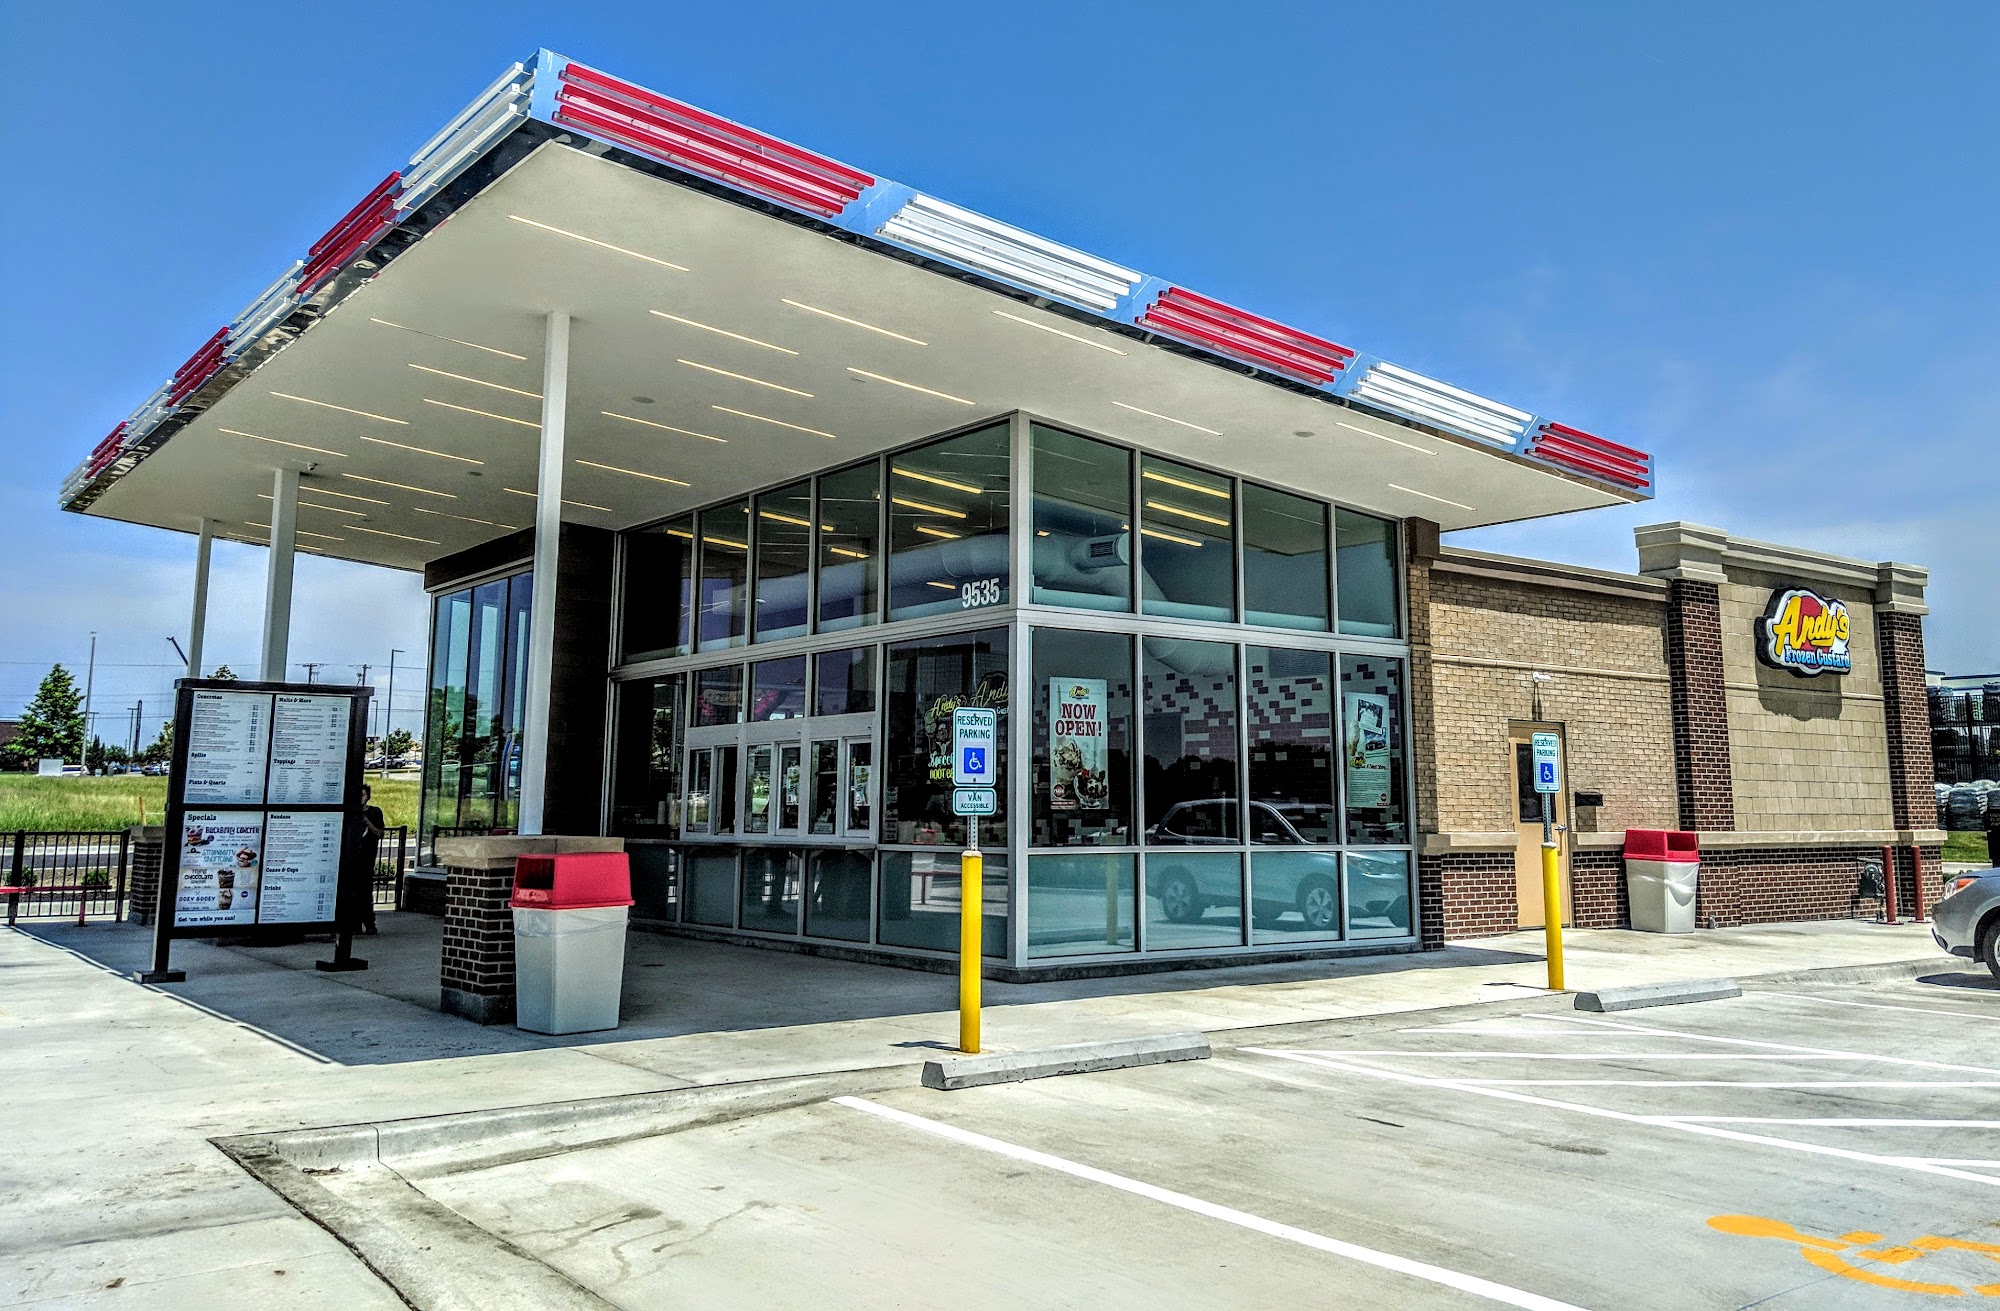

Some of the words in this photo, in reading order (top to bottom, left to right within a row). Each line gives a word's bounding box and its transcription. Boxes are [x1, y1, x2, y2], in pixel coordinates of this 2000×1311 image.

[962, 578, 1000, 608] 9535
[1773, 595, 1848, 656] Andy's
[1784, 645, 1816, 664] Frozen
[1817, 649, 1851, 668] Custard
[930, 694, 962, 717] Andy's
[1061, 703, 1097, 719] NOW
[957, 715, 993, 727] RESERVED
[1055, 720, 1102, 737] OPEN!
[959, 729, 991, 740] PARKING
[1535, 739, 1557, 747] RESERVED
[1536, 749, 1556, 757] PARKING
[967, 794, 982, 802] VAN
